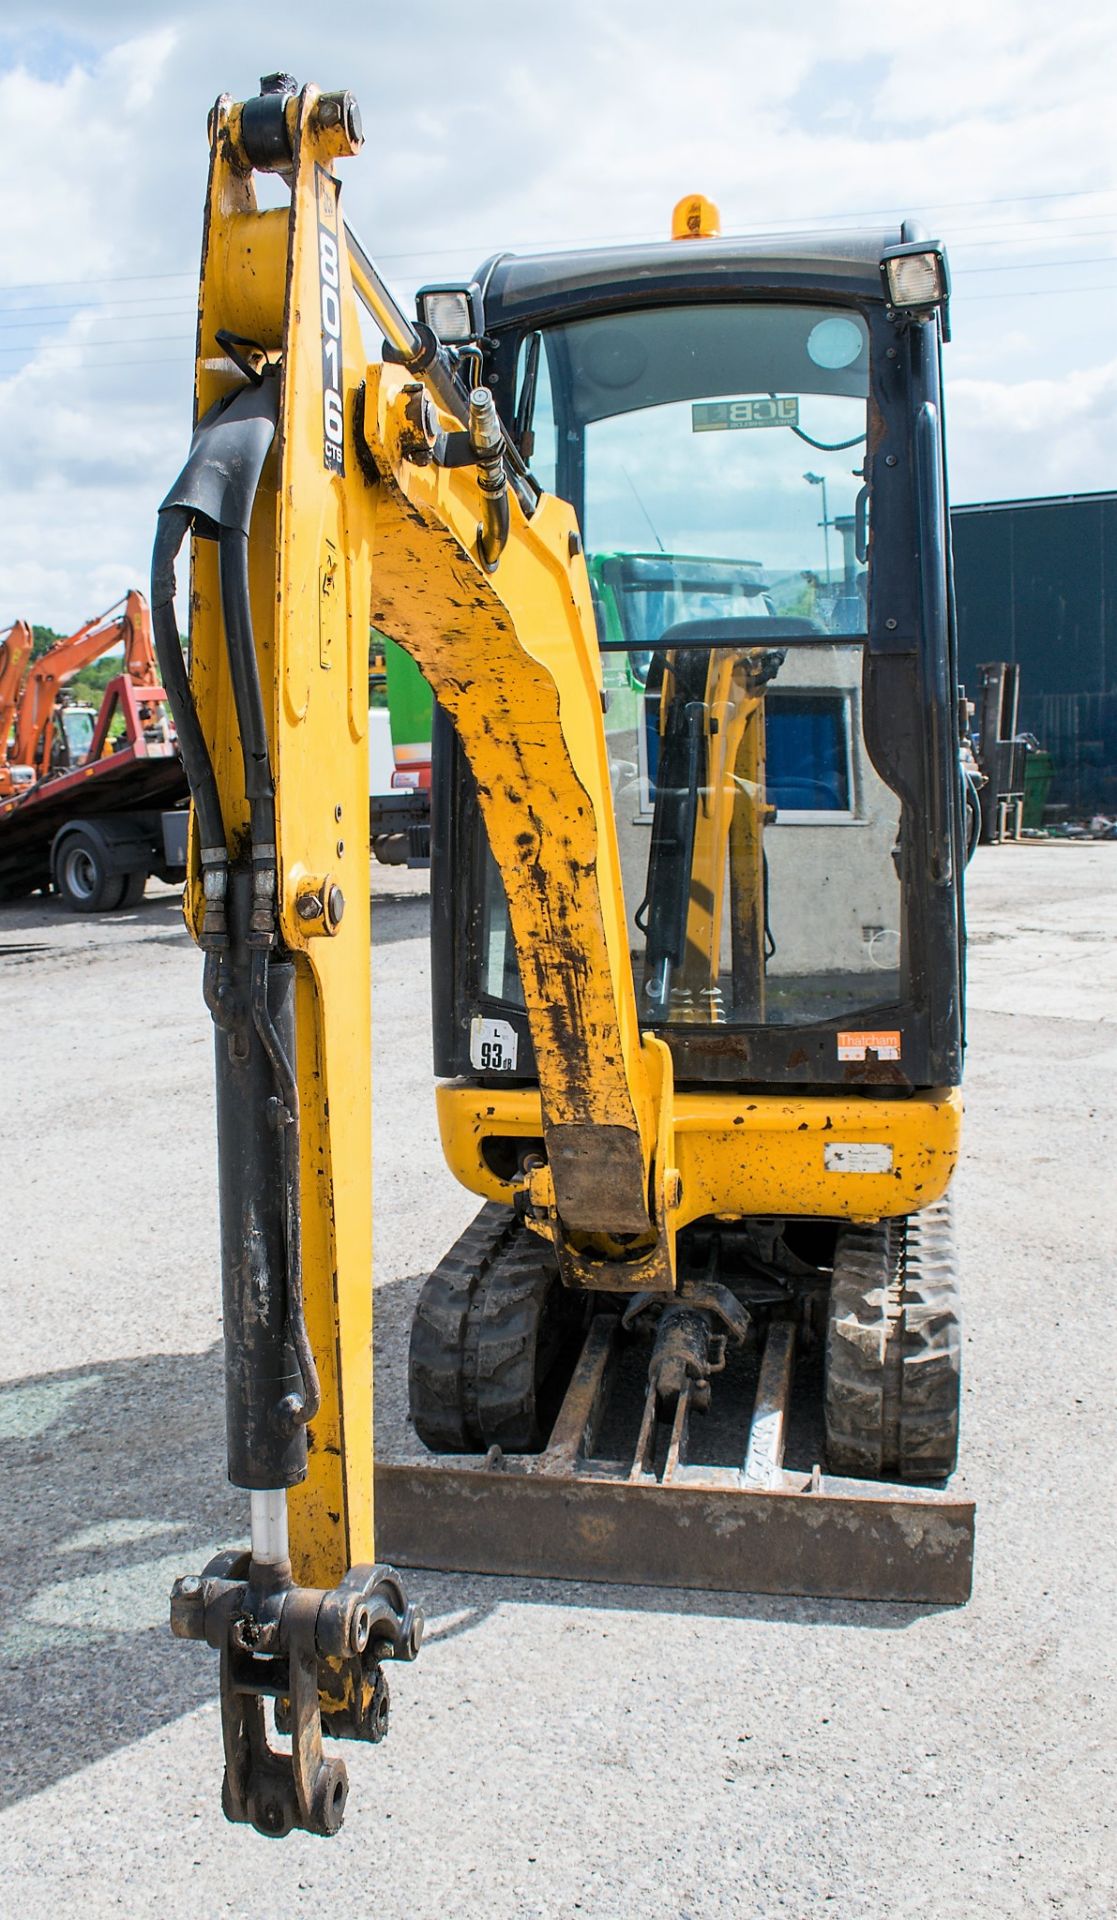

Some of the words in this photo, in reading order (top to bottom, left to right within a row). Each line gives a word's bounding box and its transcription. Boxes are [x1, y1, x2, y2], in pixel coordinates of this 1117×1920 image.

[320, 232, 342, 445] 8016
[325, 441, 342, 463] CTS
[840, 1034, 897, 1046] Thatcham
[481, 1043, 502, 1068] 93
